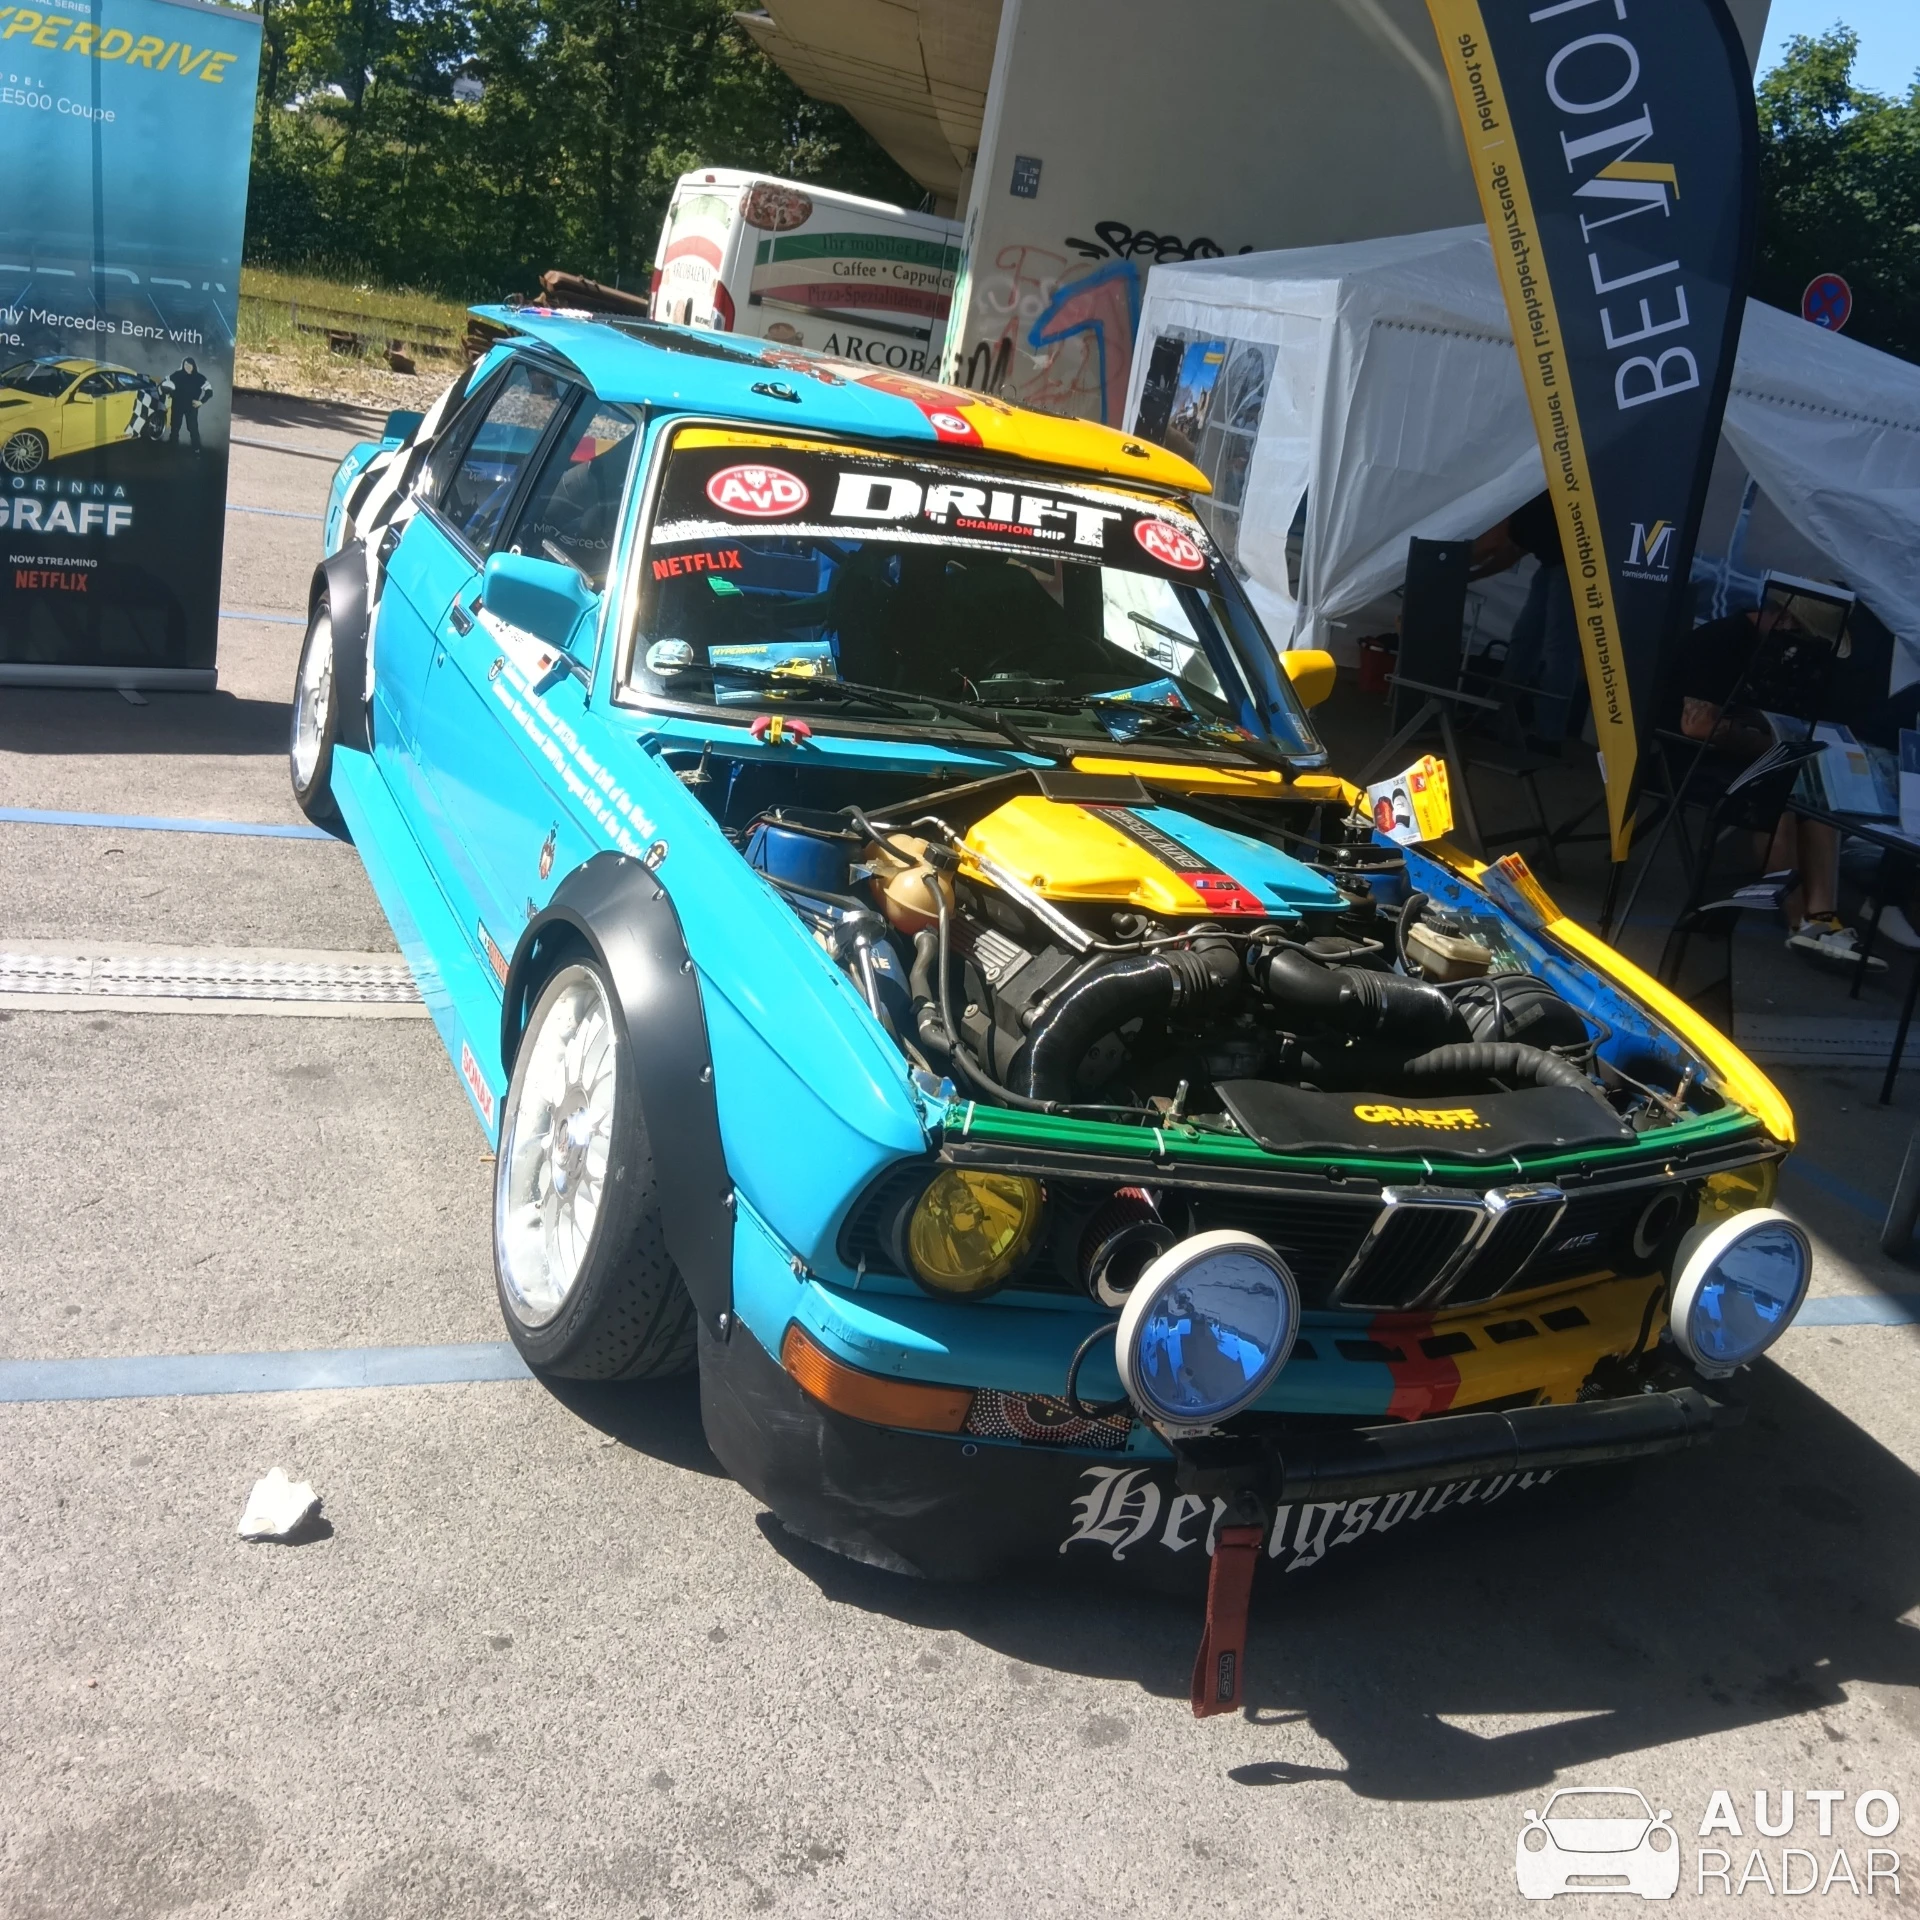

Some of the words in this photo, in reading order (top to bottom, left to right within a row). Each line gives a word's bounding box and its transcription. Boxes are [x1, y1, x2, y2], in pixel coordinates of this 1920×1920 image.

[54, 0, 91, 13] SERIES
[2, 87, 52, 110] E500
[57, 97, 115, 122] Coupe
[822, 234, 847, 250] Ihr
[850, 237, 910, 255] mobiler
[832, 261, 876, 277] Caffee
[808, 285, 922, 310] Pizza-Spezialitäten
[30, 307, 115, 334] Mercedes
[121, 320, 163, 339] Benz
[169, 327, 202, 345] with
[830, 472, 1121, 548] DRIFT
[956, 518, 1065, 540] CHAMPIONSHIP
[9, 555, 36, 565] NOW
[37, 556, 98, 568] STREAMING
[652, 550, 742, 581] NETFLIX
[15, 569, 88, 592] NETFLIX
[712, 645, 768, 656] HYPERDRIVE
[1153, 842, 1204, 868] BMW
[1353, 1105, 1479, 1126] GRAEFF
